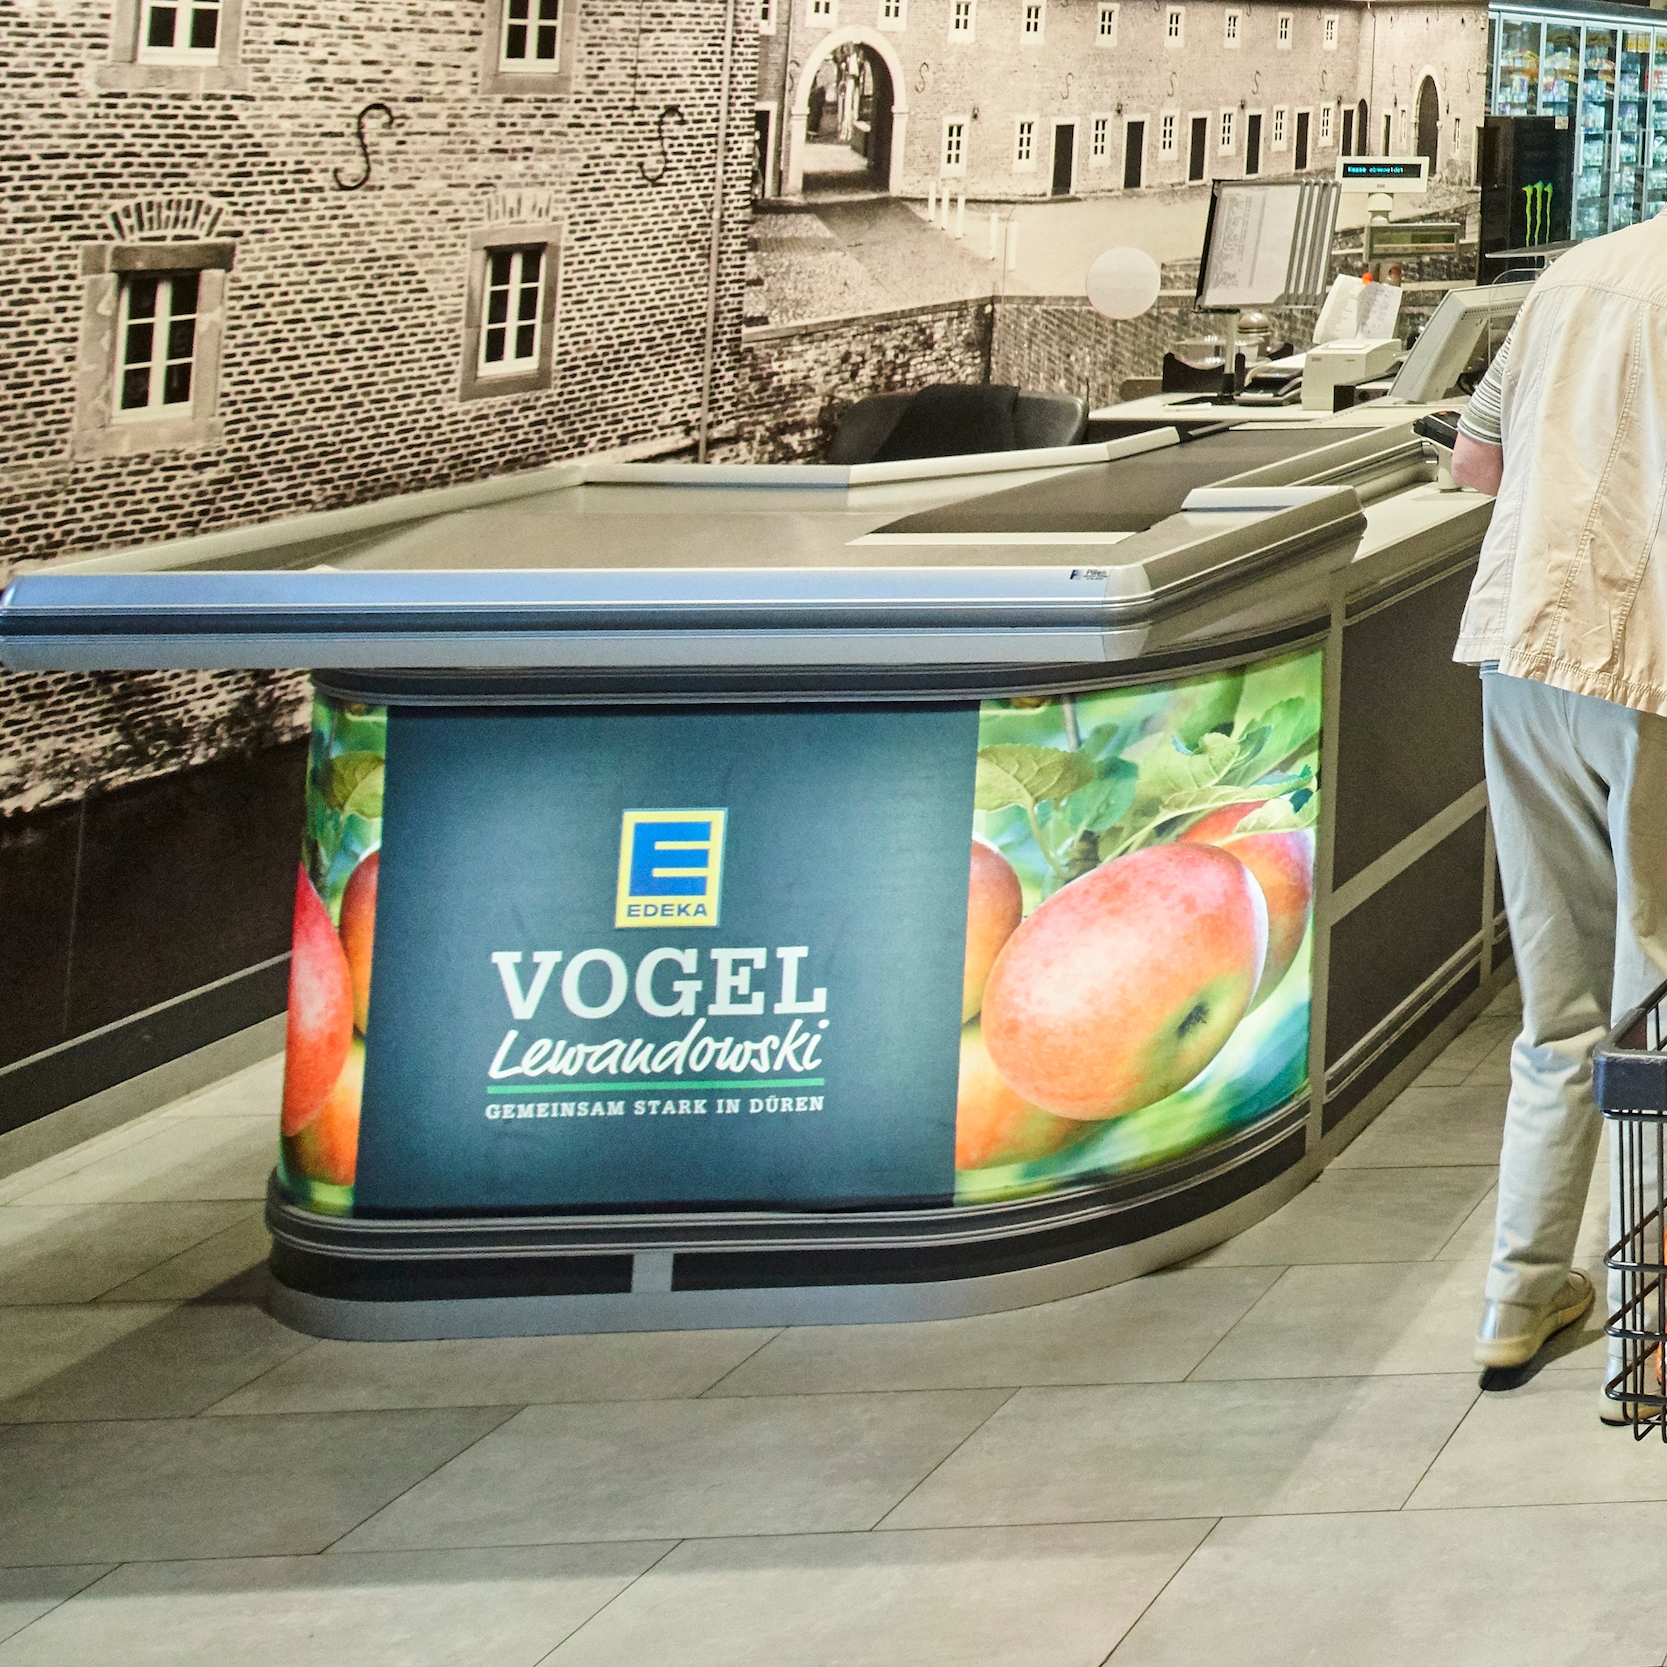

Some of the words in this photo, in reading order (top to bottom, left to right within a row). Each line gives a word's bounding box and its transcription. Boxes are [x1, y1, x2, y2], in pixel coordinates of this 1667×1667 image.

[625, 901, 708, 918] EDEKA
[491, 945, 828, 1020] VOGEL
[487, 1017, 830, 1079] Lewandowski
[485, 1100, 625, 1119] GEMEINSAM
[633, 1097, 710, 1116] STARK
[716, 1096, 742, 1115] IN
[748, 1092, 825, 1115] DÜREN
